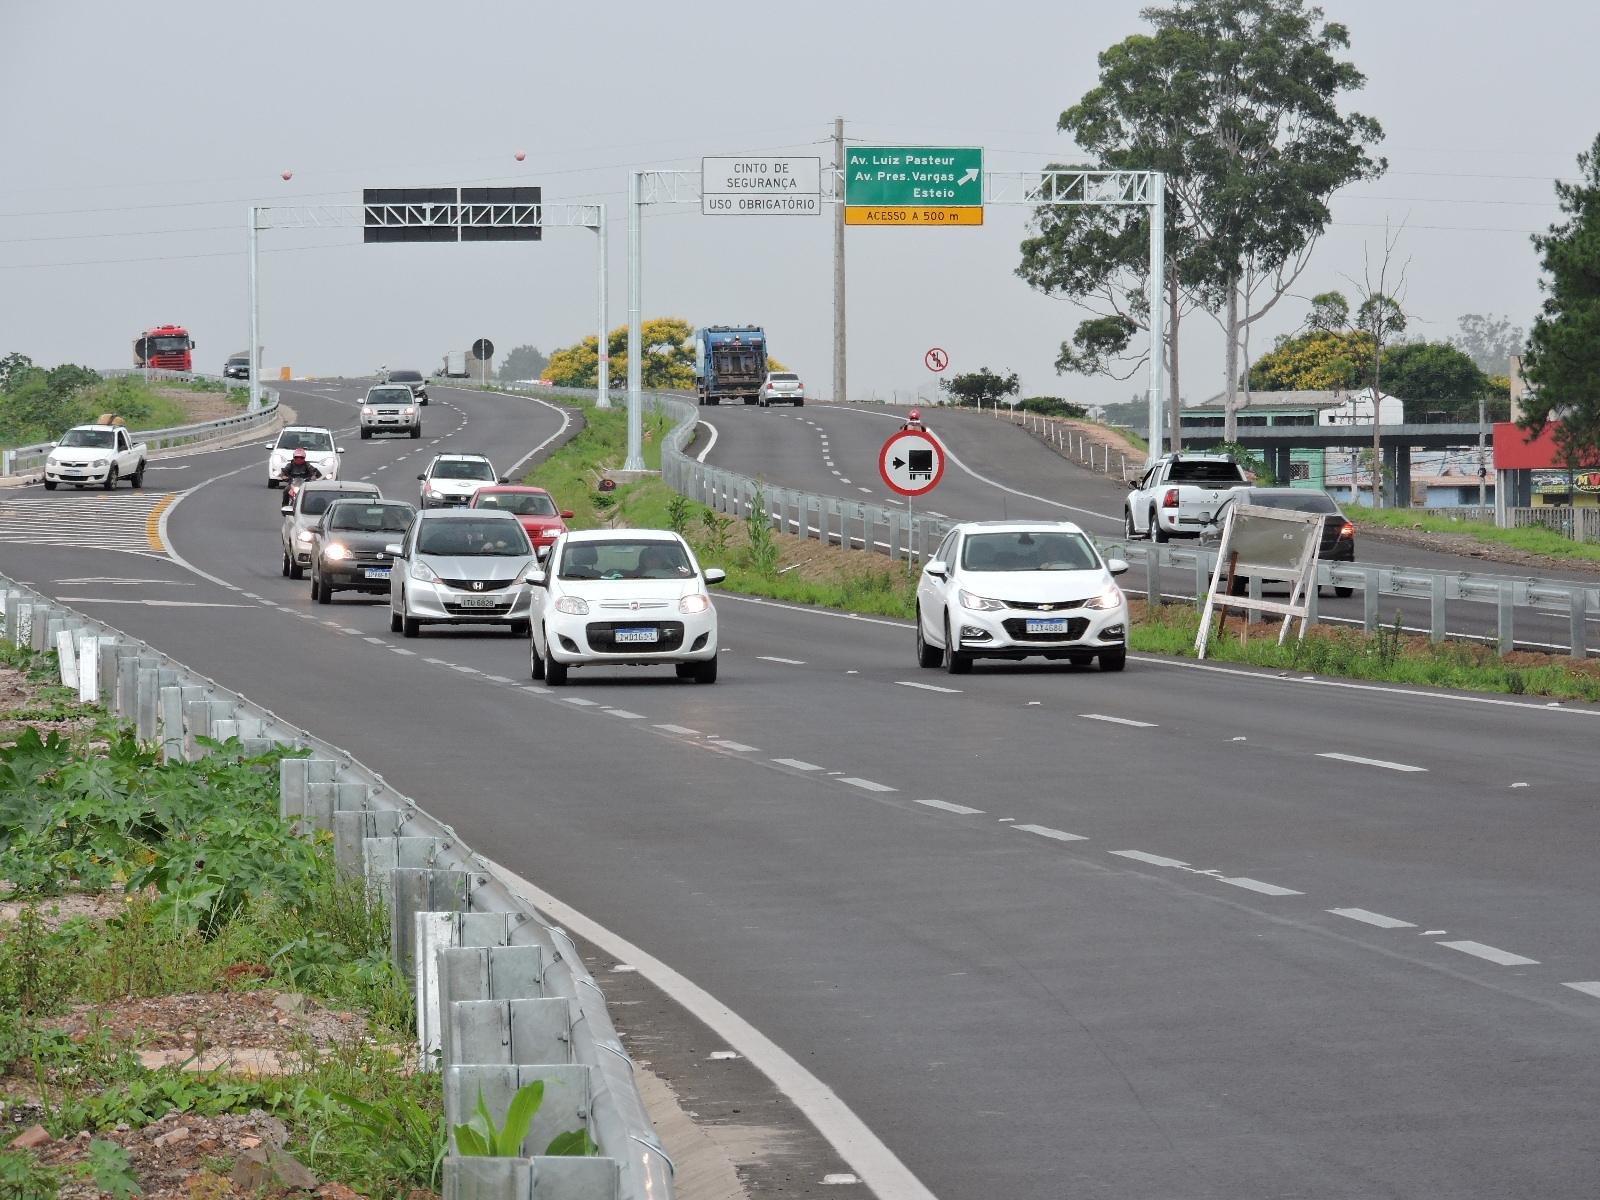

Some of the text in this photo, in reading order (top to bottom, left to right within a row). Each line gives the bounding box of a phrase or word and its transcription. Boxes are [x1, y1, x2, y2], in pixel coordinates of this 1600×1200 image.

[850, 155, 955, 165] Av. Luiz Pasteur
[734, 163, 789, 174] CINTO DE
[855, 171, 955, 184] Av. Pres. Vargas
[727, 177, 797, 190] SEGURANÇA
[913, 187, 955, 198] Esteio
[709, 196, 815, 210] USO OBRIGATÓRIO
[866, 211, 959, 221] ACESSO A 500 m
